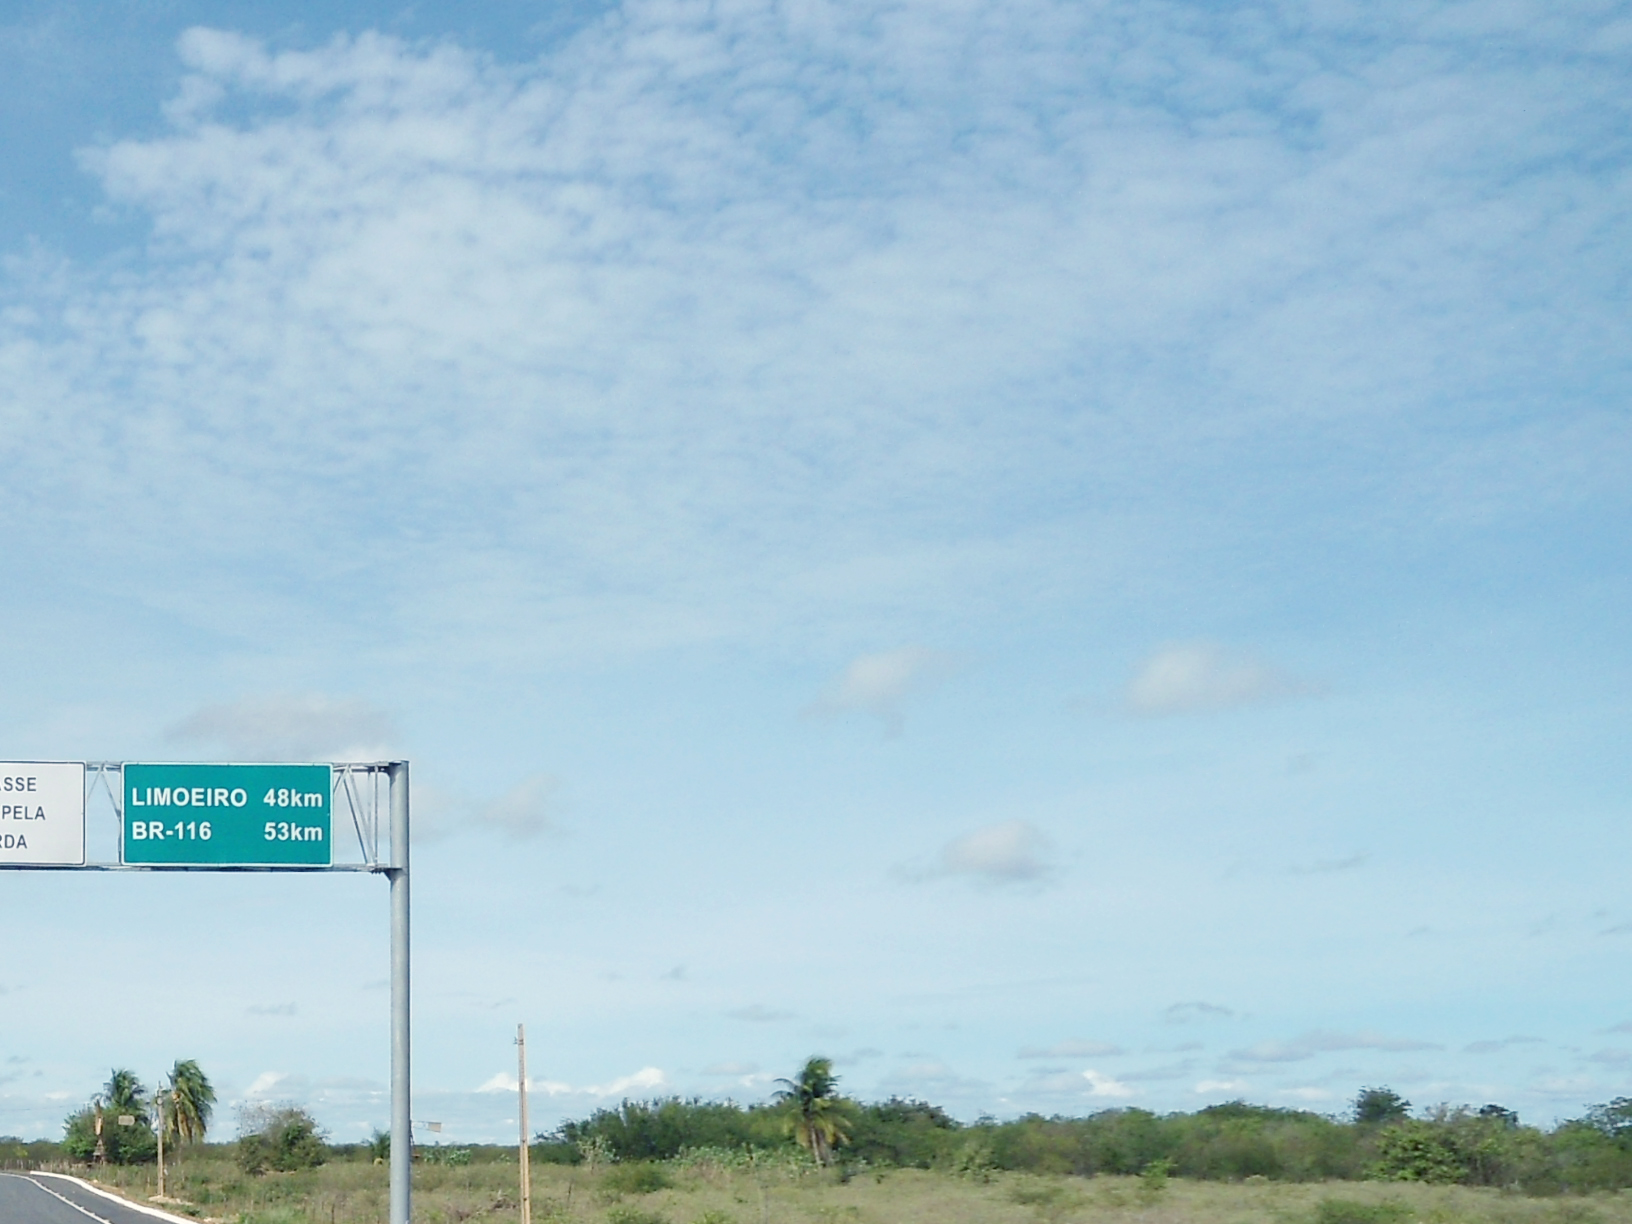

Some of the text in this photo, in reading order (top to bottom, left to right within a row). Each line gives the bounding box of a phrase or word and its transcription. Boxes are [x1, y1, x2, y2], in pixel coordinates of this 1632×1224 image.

[131, 787, 323, 808] LIMOEIRO 48km
[1, 805, 46, 821] PELA
[131, 821, 323, 841] BR-116 53km
